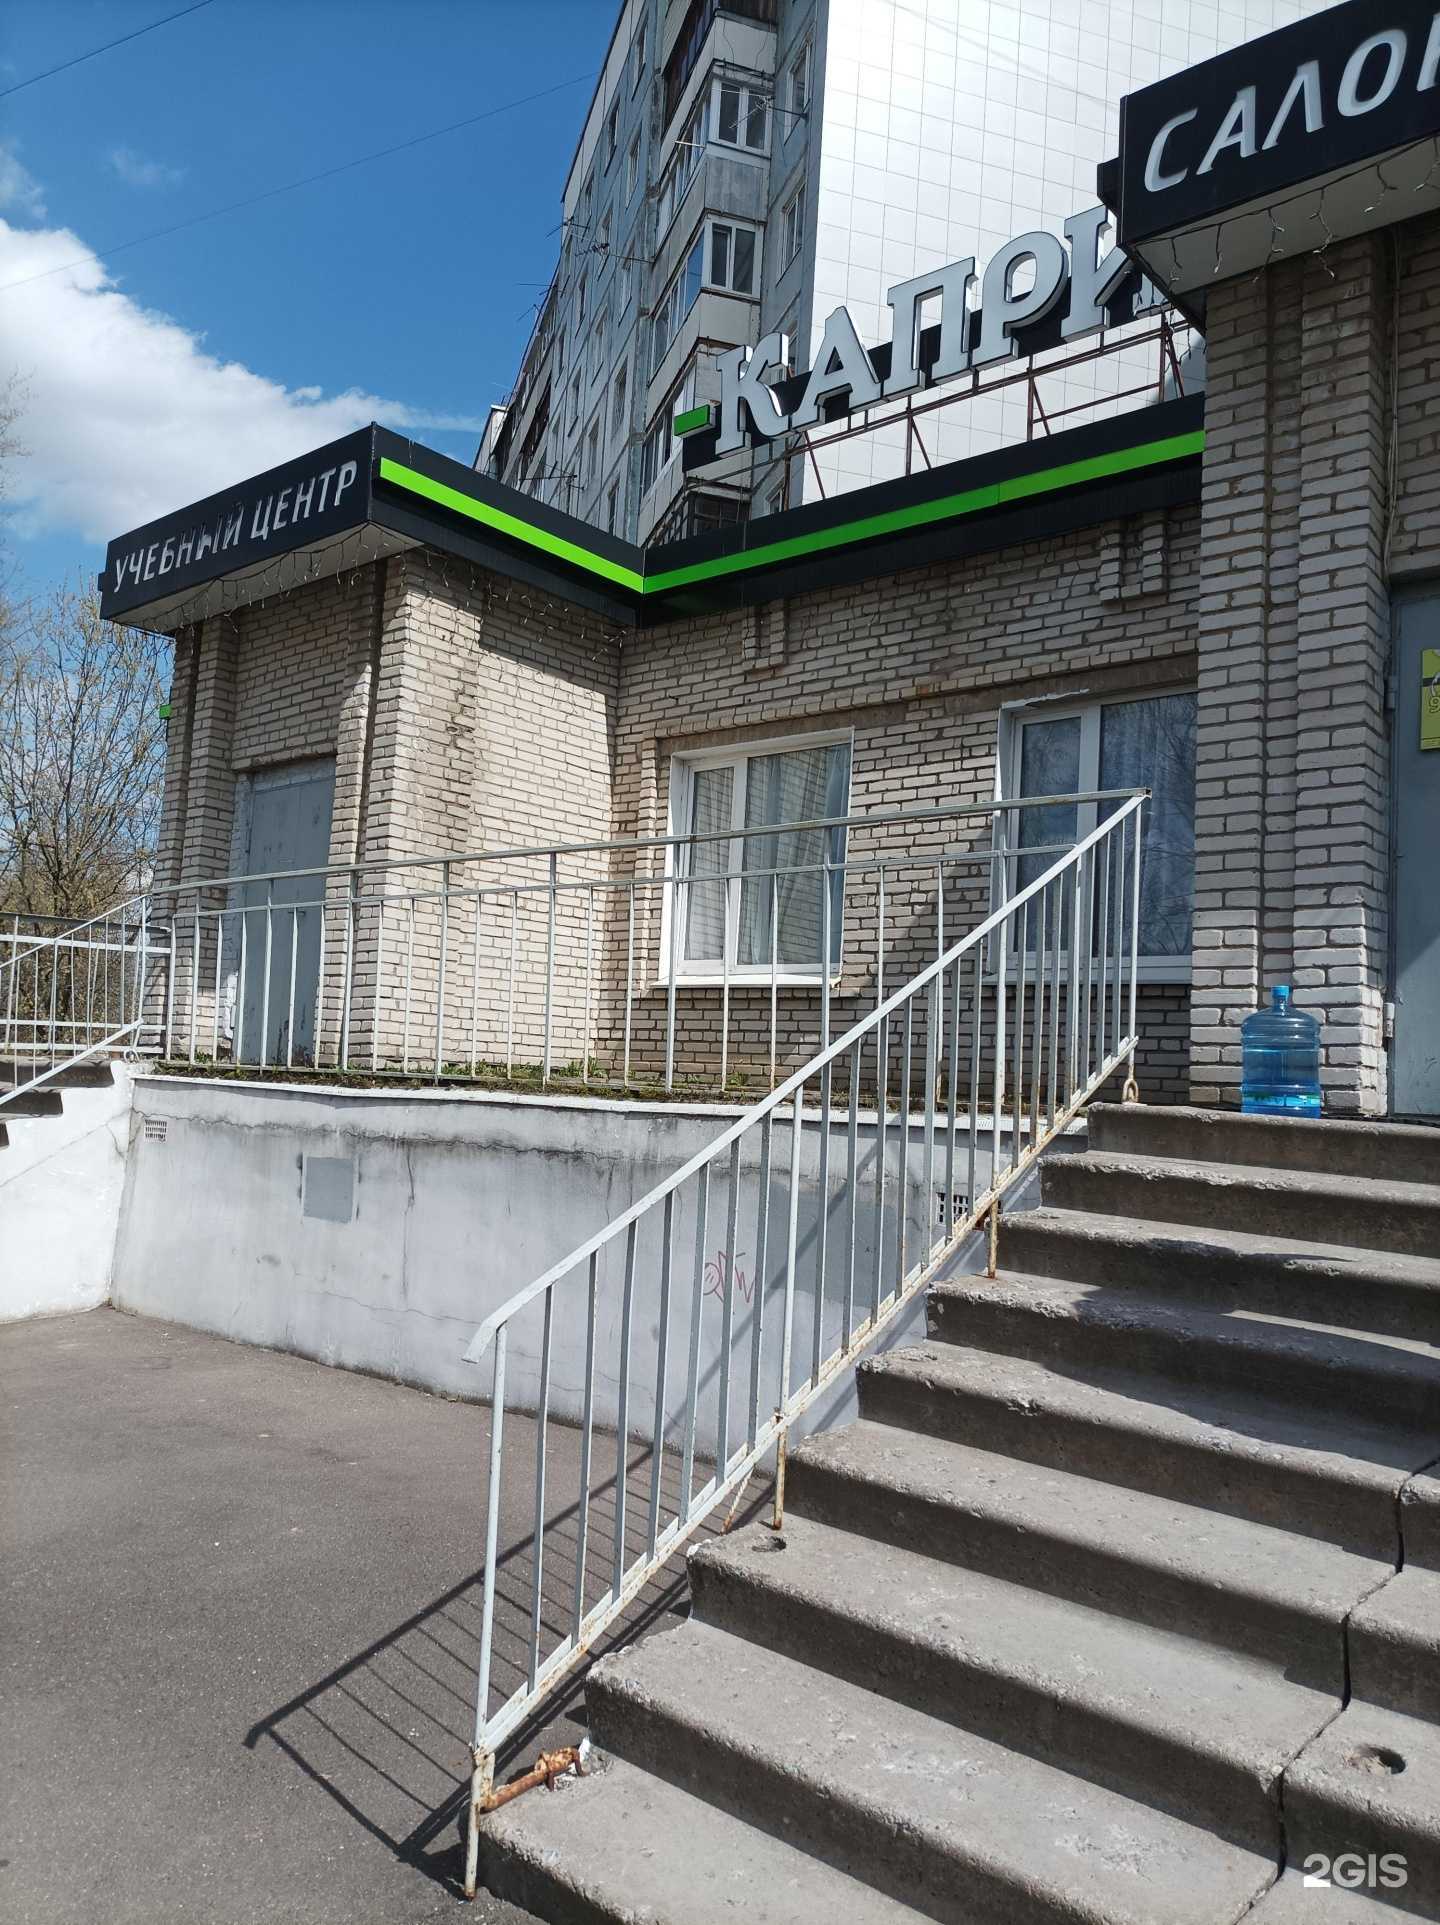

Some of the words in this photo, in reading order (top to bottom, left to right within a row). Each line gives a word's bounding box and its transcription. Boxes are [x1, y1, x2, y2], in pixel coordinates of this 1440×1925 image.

[1144, 12, 1440, 192] САЛО
[113, 501, 245, 593] УЧЕБНЫЙ
[250, 460, 358, 541] ЦЕНТР
